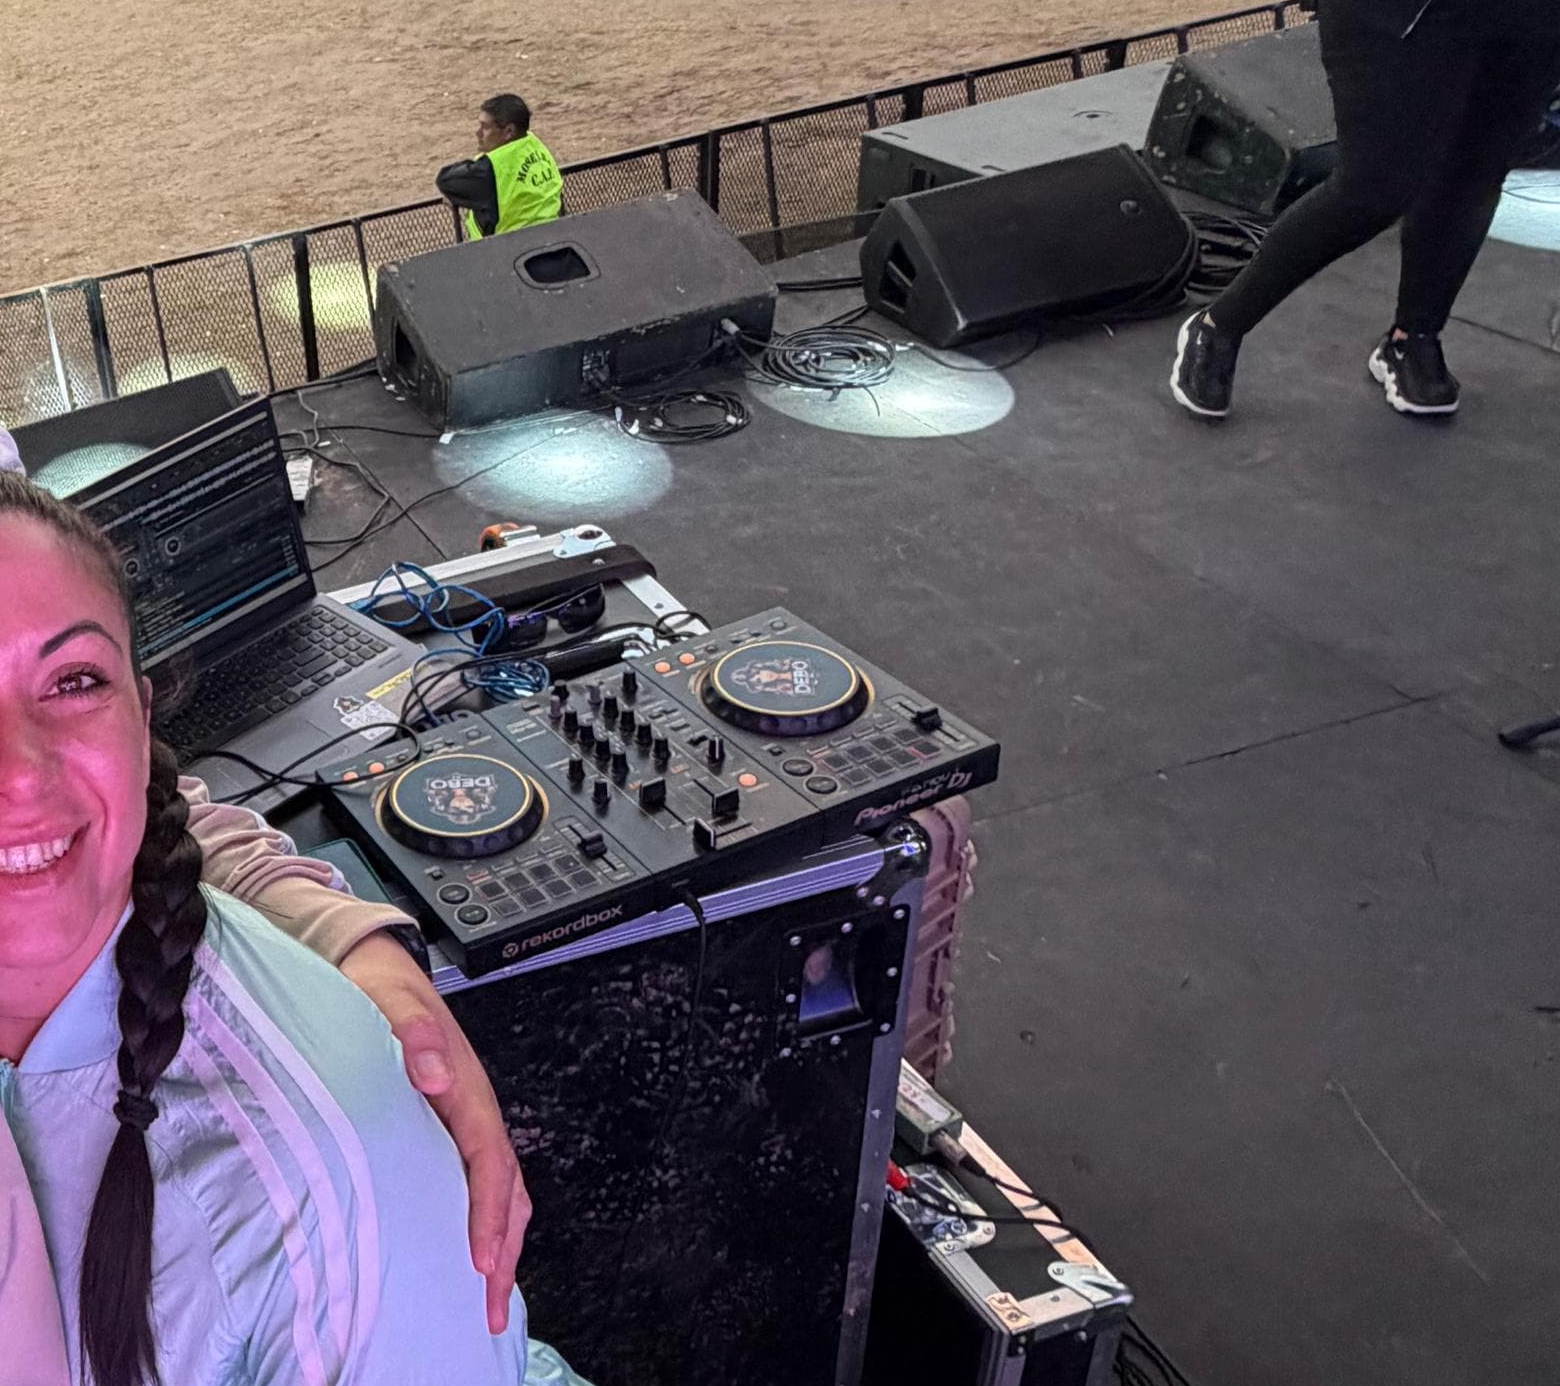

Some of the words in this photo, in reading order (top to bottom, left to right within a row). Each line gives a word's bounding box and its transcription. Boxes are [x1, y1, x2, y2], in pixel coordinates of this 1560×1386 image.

[791, 660, 811, 693] DEBO
[430, 776, 491, 790] DEBO
[854, 784, 943, 826] Pioneer
[946, 772, 973, 789] DJ
[521, 904, 623, 951] rekordbox
